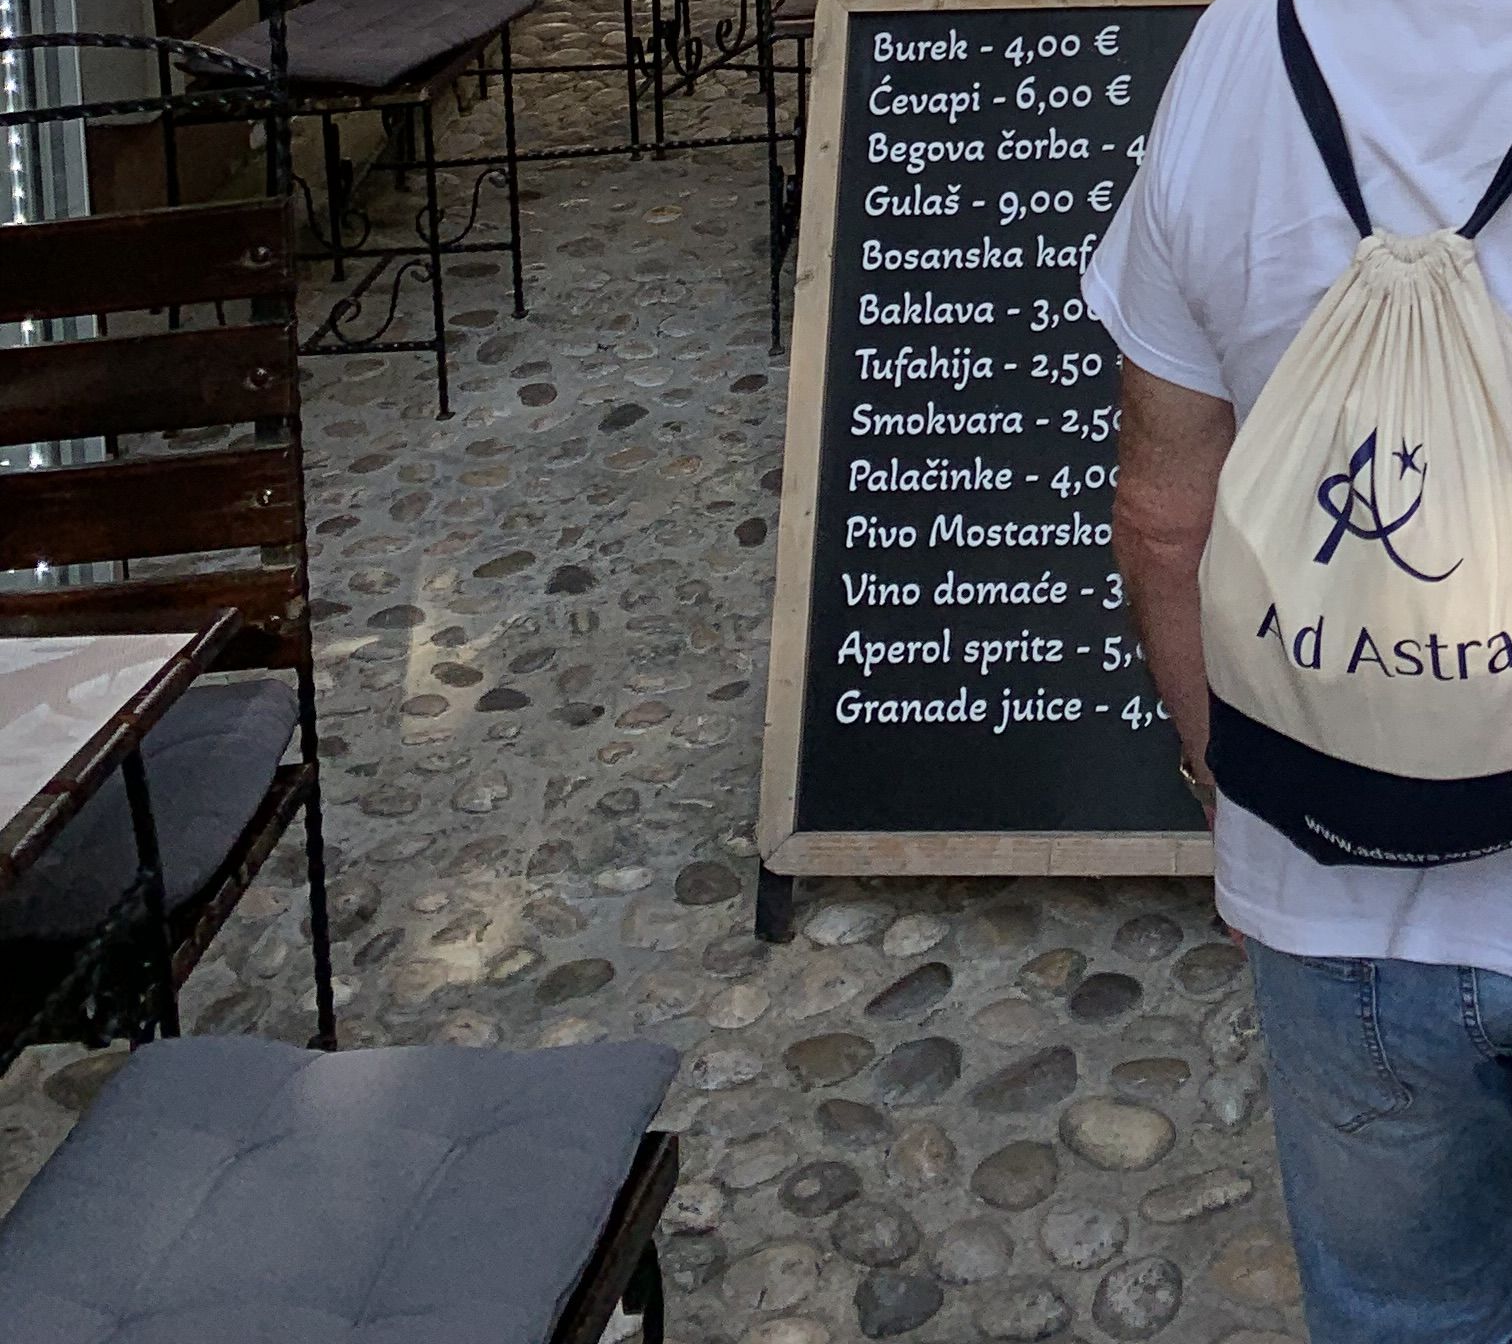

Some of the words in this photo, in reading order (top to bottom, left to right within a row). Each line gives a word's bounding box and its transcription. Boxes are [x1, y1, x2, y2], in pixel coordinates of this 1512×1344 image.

[873, 28, 968, 62] Burek
[1004, 34, 1081, 67] 4,00
[1093, 24, 1121, 56] €
[869, 74, 981, 125] Ćevapi
[1016, 75, 1092, 116] 6,00
[1104, 74, 1132, 106] €
[868, 132, 985, 174] Begova
[997, 126, 1090, 161] čorba
[864, 183, 962, 216] Gulaš
[998, 190, 1074, 226] 9,00
[1086, 180, 1114, 212] €
[862, 235, 1024, 271] Bosanska
[859, 290, 995, 325] Baklava
[854, 345, 993, 391] Tufahija
[1030, 352, 1103, 386] 2,50
[850, 400, 1024, 436] Smokvara
[849, 455, 1013, 492] Palačinke
[845, 515, 917, 549] Pivo
[928, 511, 1113, 548] Mostarsko
[841, 572, 921, 606] Vino
[933, 569, 1068, 605] domaće
[837, 627, 951, 677] Aperol
[963, 629, 1064, 676] spritz
[1102, 635, 1143, 672] 5,
[1256, 603, 1324, 670] Ad
[836, 686, 987, 724] Granade
[993, 687, 1082, 734] juice
